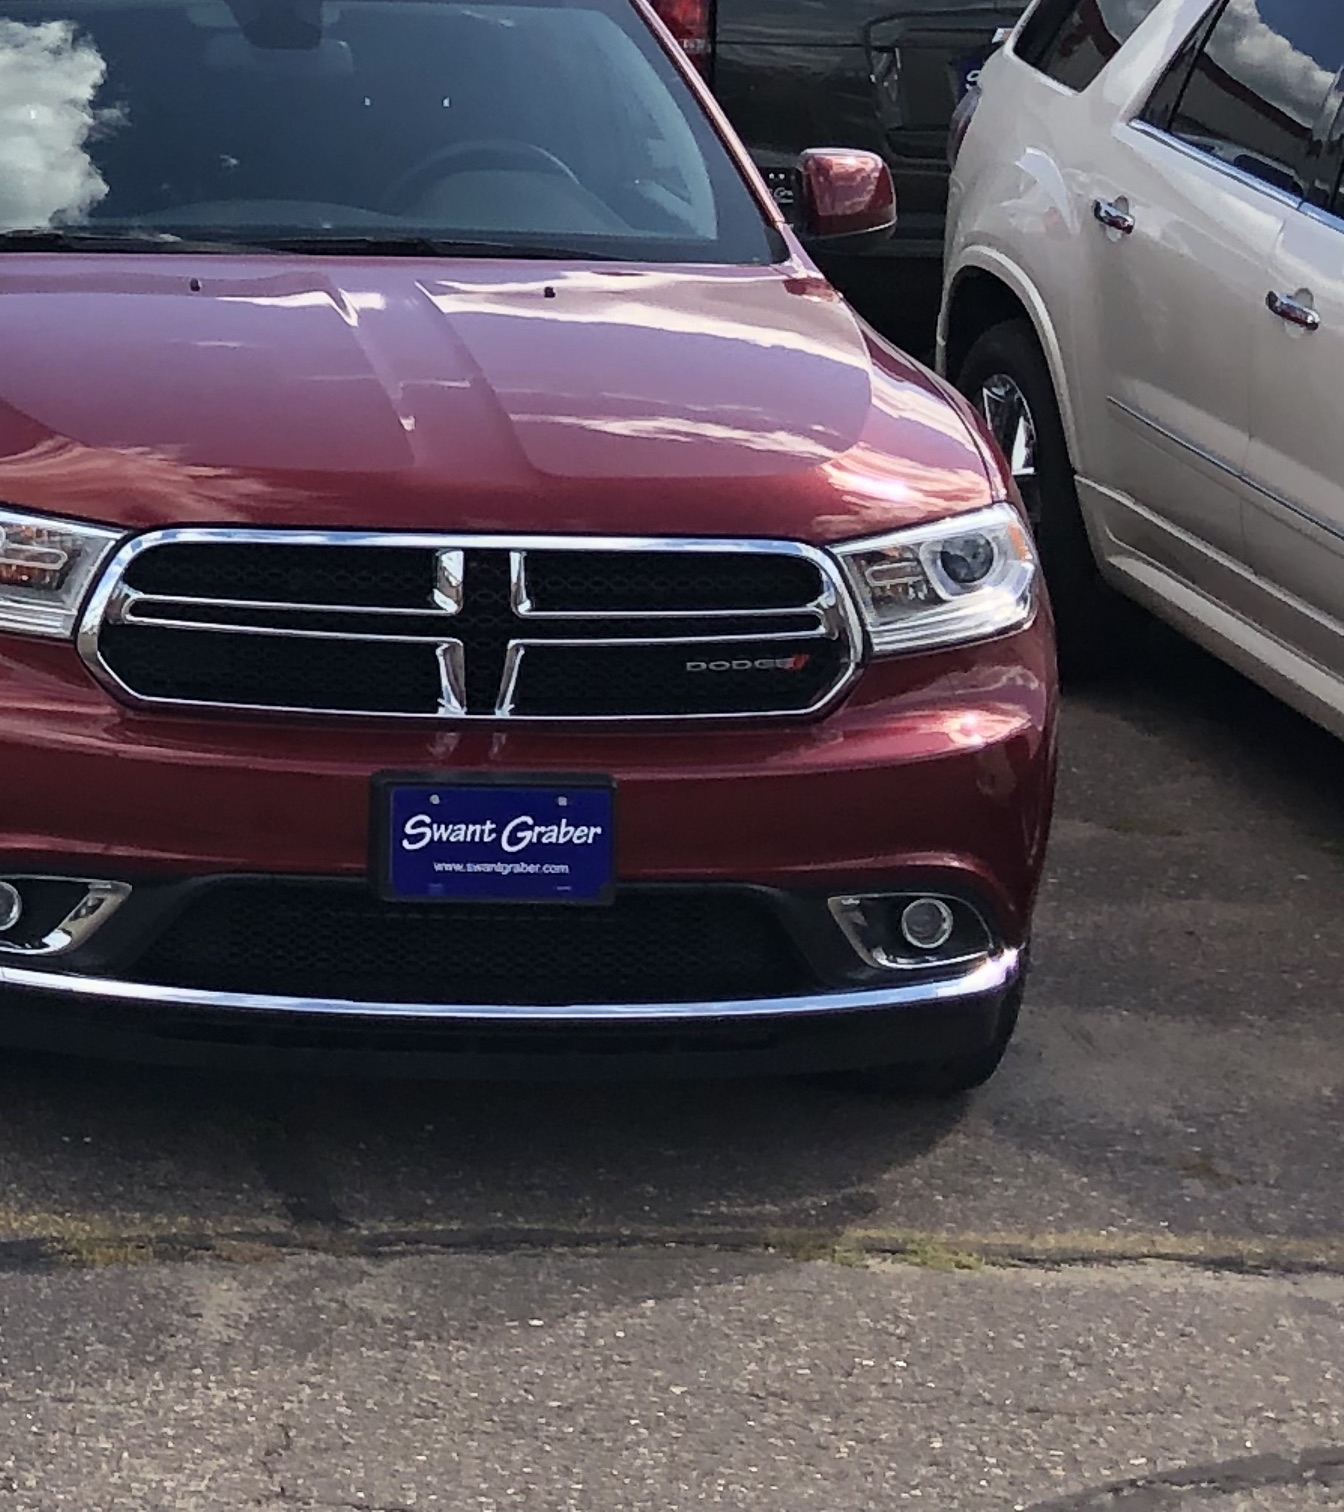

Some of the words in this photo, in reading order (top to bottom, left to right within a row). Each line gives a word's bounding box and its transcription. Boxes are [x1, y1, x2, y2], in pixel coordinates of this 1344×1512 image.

[686, 658, 795, 671] DODGE
[402, 814, 497, 850] Swant
[501, 815, 602, 853] Graber
[433, 861, 570, 875] www.swantgraber.com
